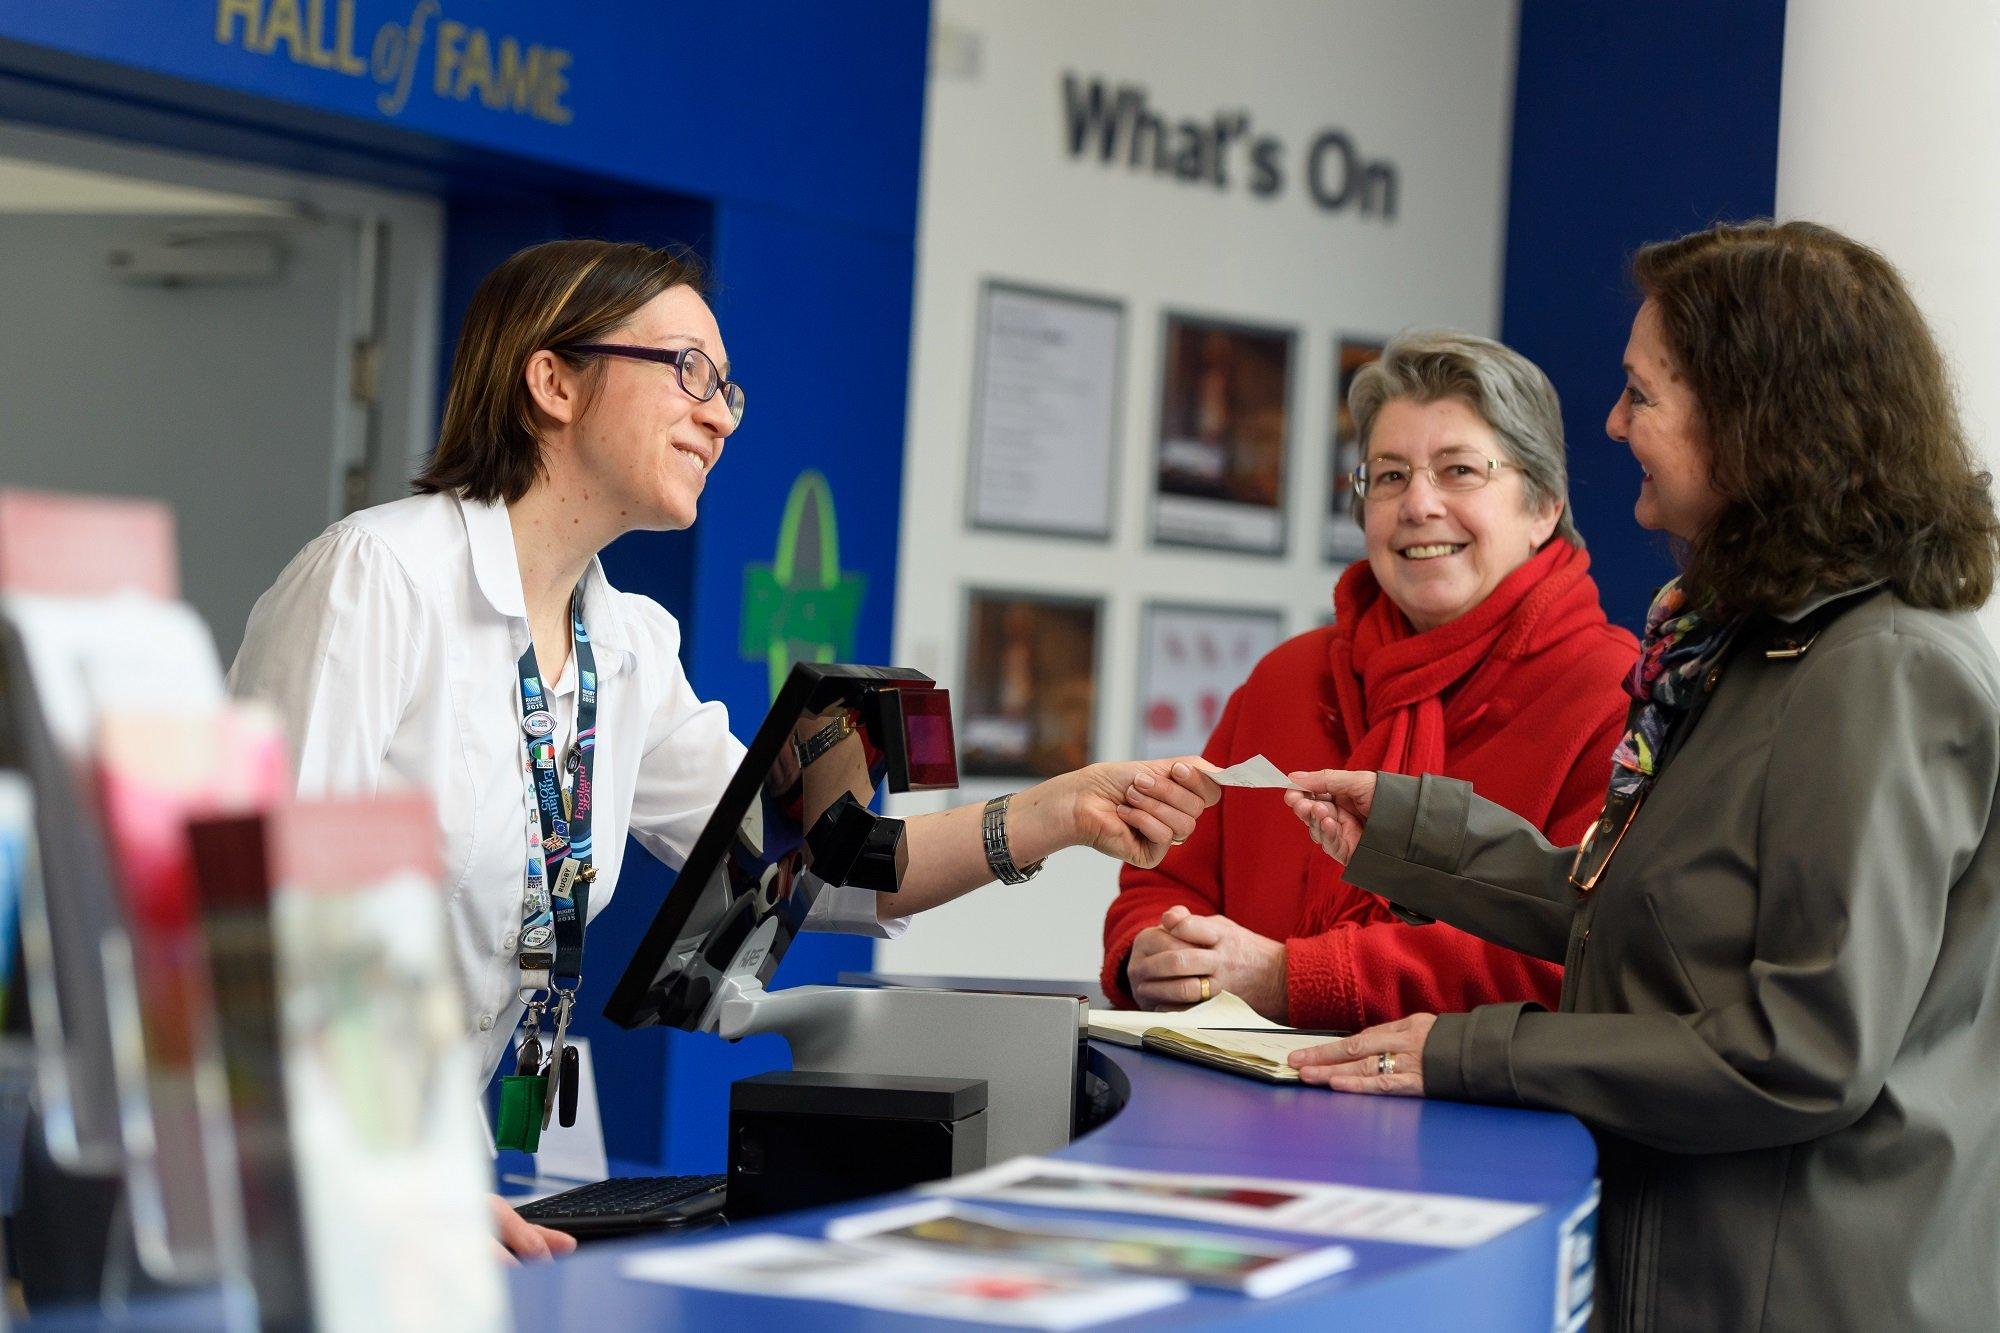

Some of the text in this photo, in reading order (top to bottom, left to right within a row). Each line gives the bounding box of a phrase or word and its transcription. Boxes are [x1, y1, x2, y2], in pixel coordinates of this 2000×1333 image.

[215, 0, 574, 126] HALL of FAME
[1060, 69, 1402, 229] What's On
[527, 703, 543, 711] 2015
[539, 780, 552, 811] 2015
[575, 764, 586, 820] England
[558, 868, 571, 893] RUGBY
